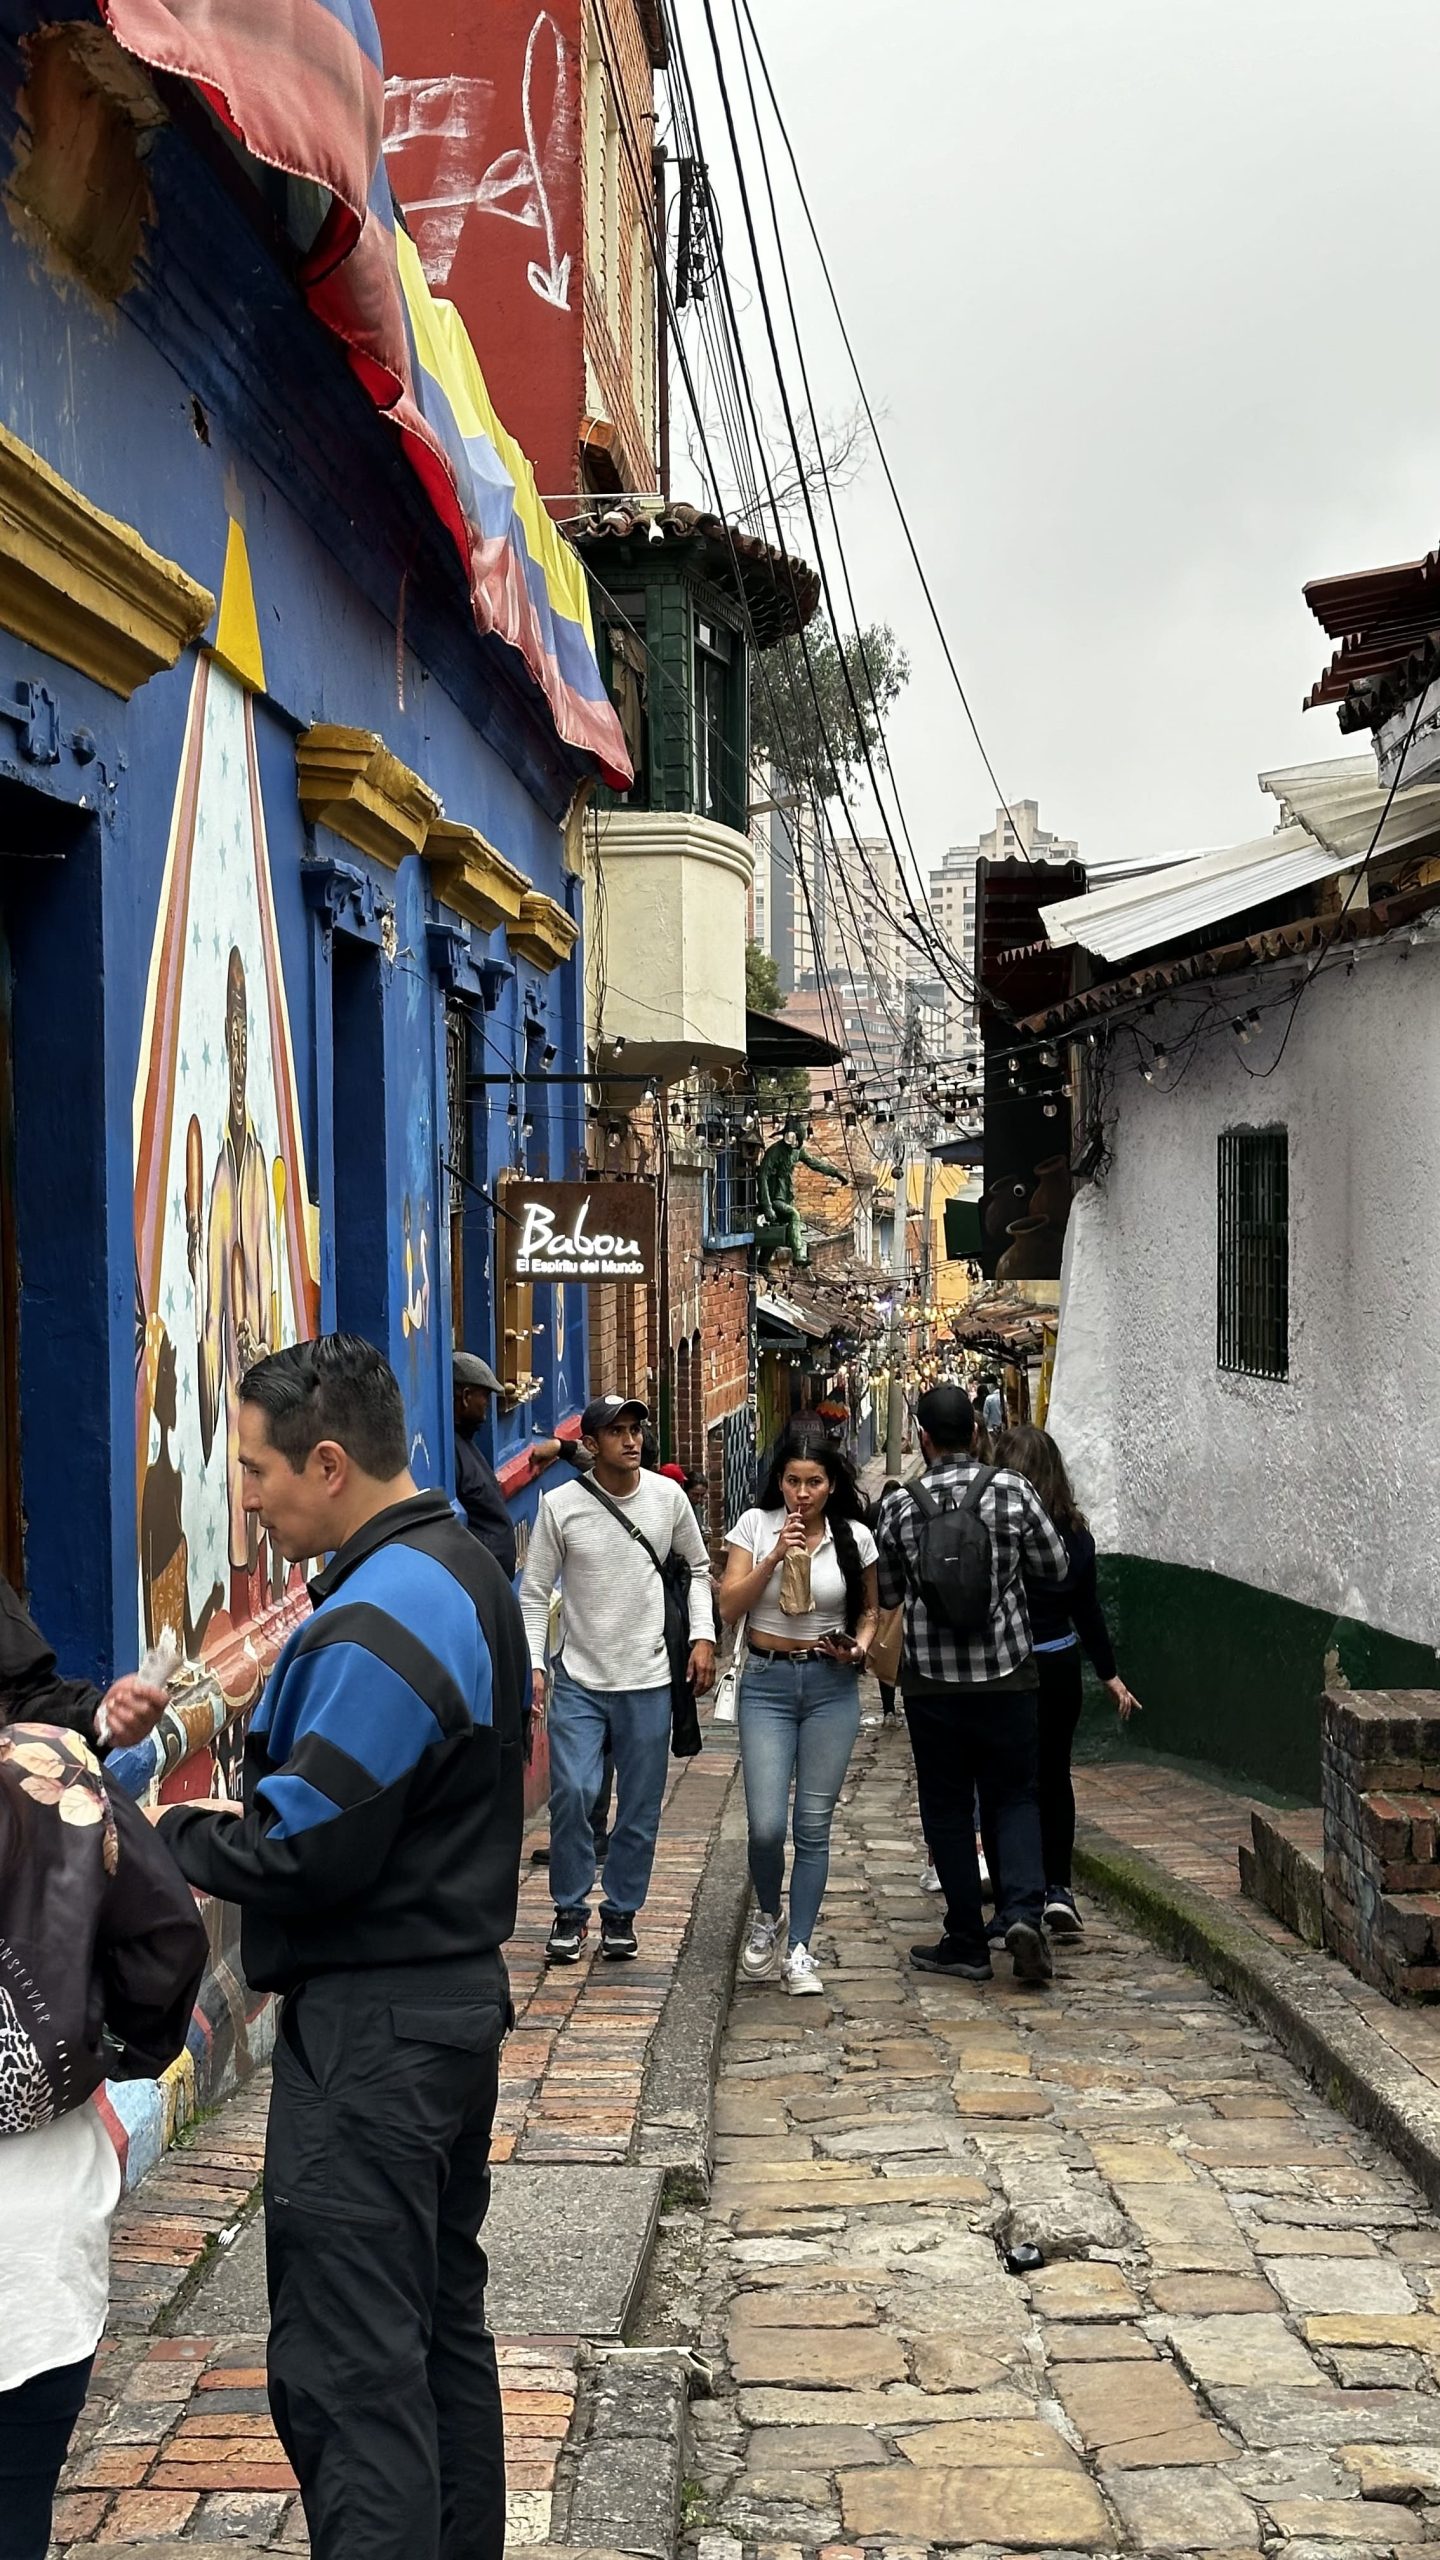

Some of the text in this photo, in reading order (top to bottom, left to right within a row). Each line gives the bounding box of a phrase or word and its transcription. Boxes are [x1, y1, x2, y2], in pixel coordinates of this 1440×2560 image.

[517, 1195, 641, 1259] Babou
[516, 1258, 644, 1274] El Espíritu del Mundo
